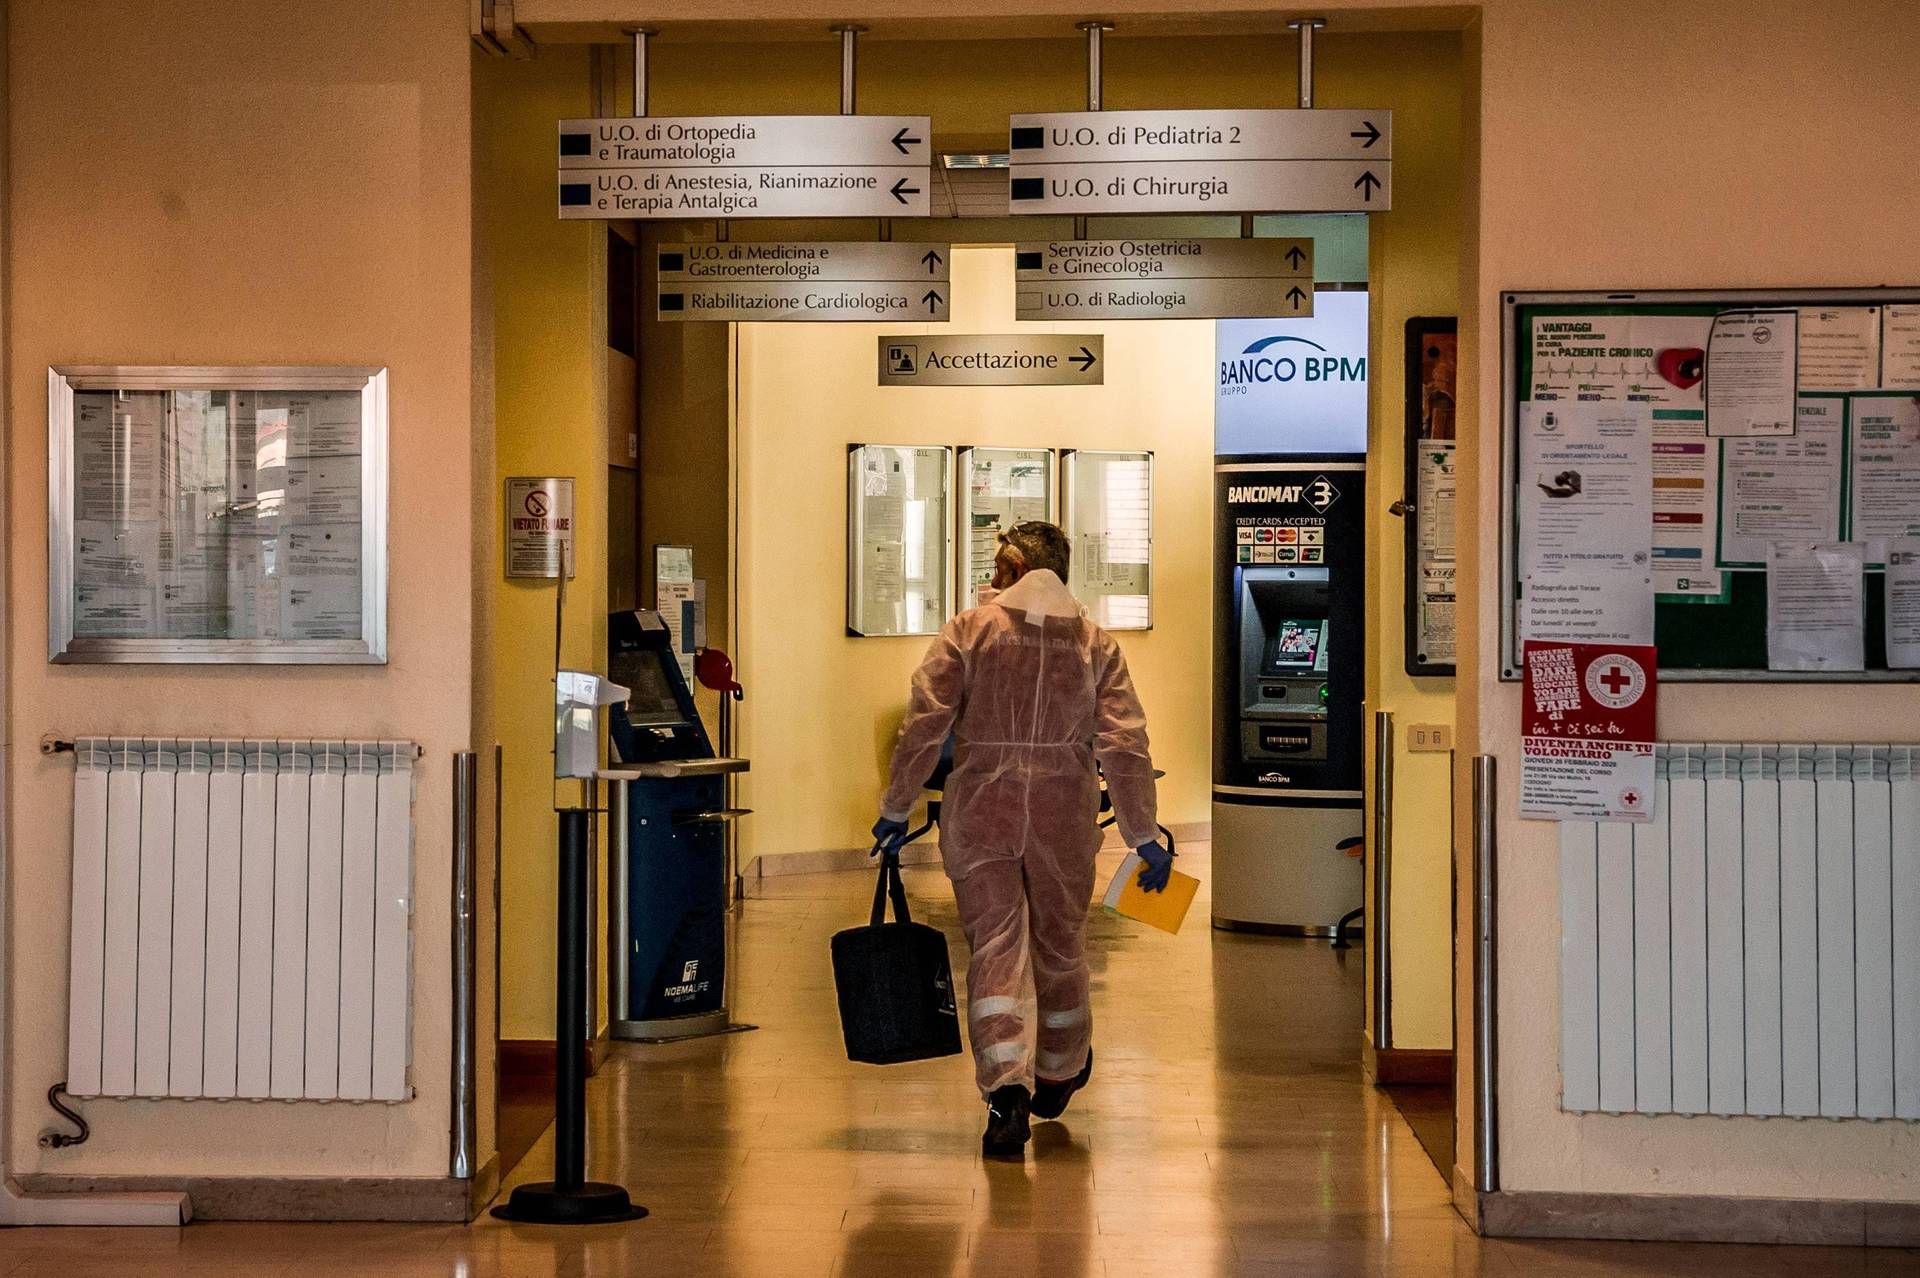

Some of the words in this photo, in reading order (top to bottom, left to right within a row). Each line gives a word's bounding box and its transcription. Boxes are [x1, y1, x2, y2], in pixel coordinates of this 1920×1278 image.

[600, 125, 640, 141] U.O.
[645, 125, 661, 141] di
[666, 124, 756, 146] Ortopedia
[1052, 128, 1099, 146] U.O.
[1108, 127, 1126, 145] di
[1134, 126, 1222, 145] Pediatria
[1229, 127, 1241, 144] 2
[600, 149, 609, 160] e
[612, 144, 736, 164] Traumatologia
[598, 175, 638, 191] U.O.
[644, 174, 660, 190] di
[664, 174, 753, 191] Anestesia,
[759, 173, 877, 190] Rianimazione
[1051, 179, 1099, 197] U.O.
[1107, 178, 1125, 196] di
[1132, 176, 1228, 200] Chirurgia
[598, 199, 607, 210] e
[612, 194, 673, 214] Terapia
[678, 193, 758, 213] Antalgica
[689, 246, 723, 260] U.O.
[728, 246, 743, 260] di
[747, 246, 815, 260] Medicina
[819, 249, 829, 260] e
[1049, 242, 1114, 257] Servizio
[1120, 241, 1201, 256] Ostetricia
[689, 262, 820, 279] Gastroenterologia
[1049, 263, 1058, 274] e
[1063, 258, 1163, 277] Ginecologia
[691, 292, 799, 310] Riabilitazione
[804, 292, 908, 312] Cardiologica
[1048, 293, 1083, 308] U.O.
[1088, 293, 1103, 307] di
[1108, 292, 1186, 310] Radiologia
[1542, 323, 1592, 333] VANTAGGI
[925, 350, 1058, 369] Accettazione
[1559, 348, 1606, 357] PAZIENTE
[1609, 348, 1653, 357] CRONICO
[1221, 357, 1297, 385] BANCO
[1305, 357, 1366, 382] BPM
[1798, 407, 1827, 416] TENZIALE
[1228, 486, 1303, 503] BANCOMAT
[512, 518, 540, 530] VIETATO
[1236, 517, 1256, 526] CREDIT
[1257, 517, 1282, 526] CARDS
[1283, 517, 1326, 526] ACCEPTED
[1239, 531, 1252, 539] VISA
[1529, 654, 1574, 664] AMARE
[1531, 666, 1577, 678] DARE
[1533, 680, 1579, 689] GIOCARE
[1533, 687, 1580, 697] VOLARE
[1536, 699, 1581, 713] FARE
[1549, 711, 1564, 720] di
[1584, 723, 1604, 735] sei
[1524, 738, 1583, 749] DIVENTA
[1585, 741, 1633, 752] ANCHE
[1635, 744, 1652, 753] TU
[1524, 747, 1612, 760] VOLONTARIO
[1524, 766, 1574, 774] PRESENTAZIONE
[664, 981, 709, 997] NOEMALIFE
